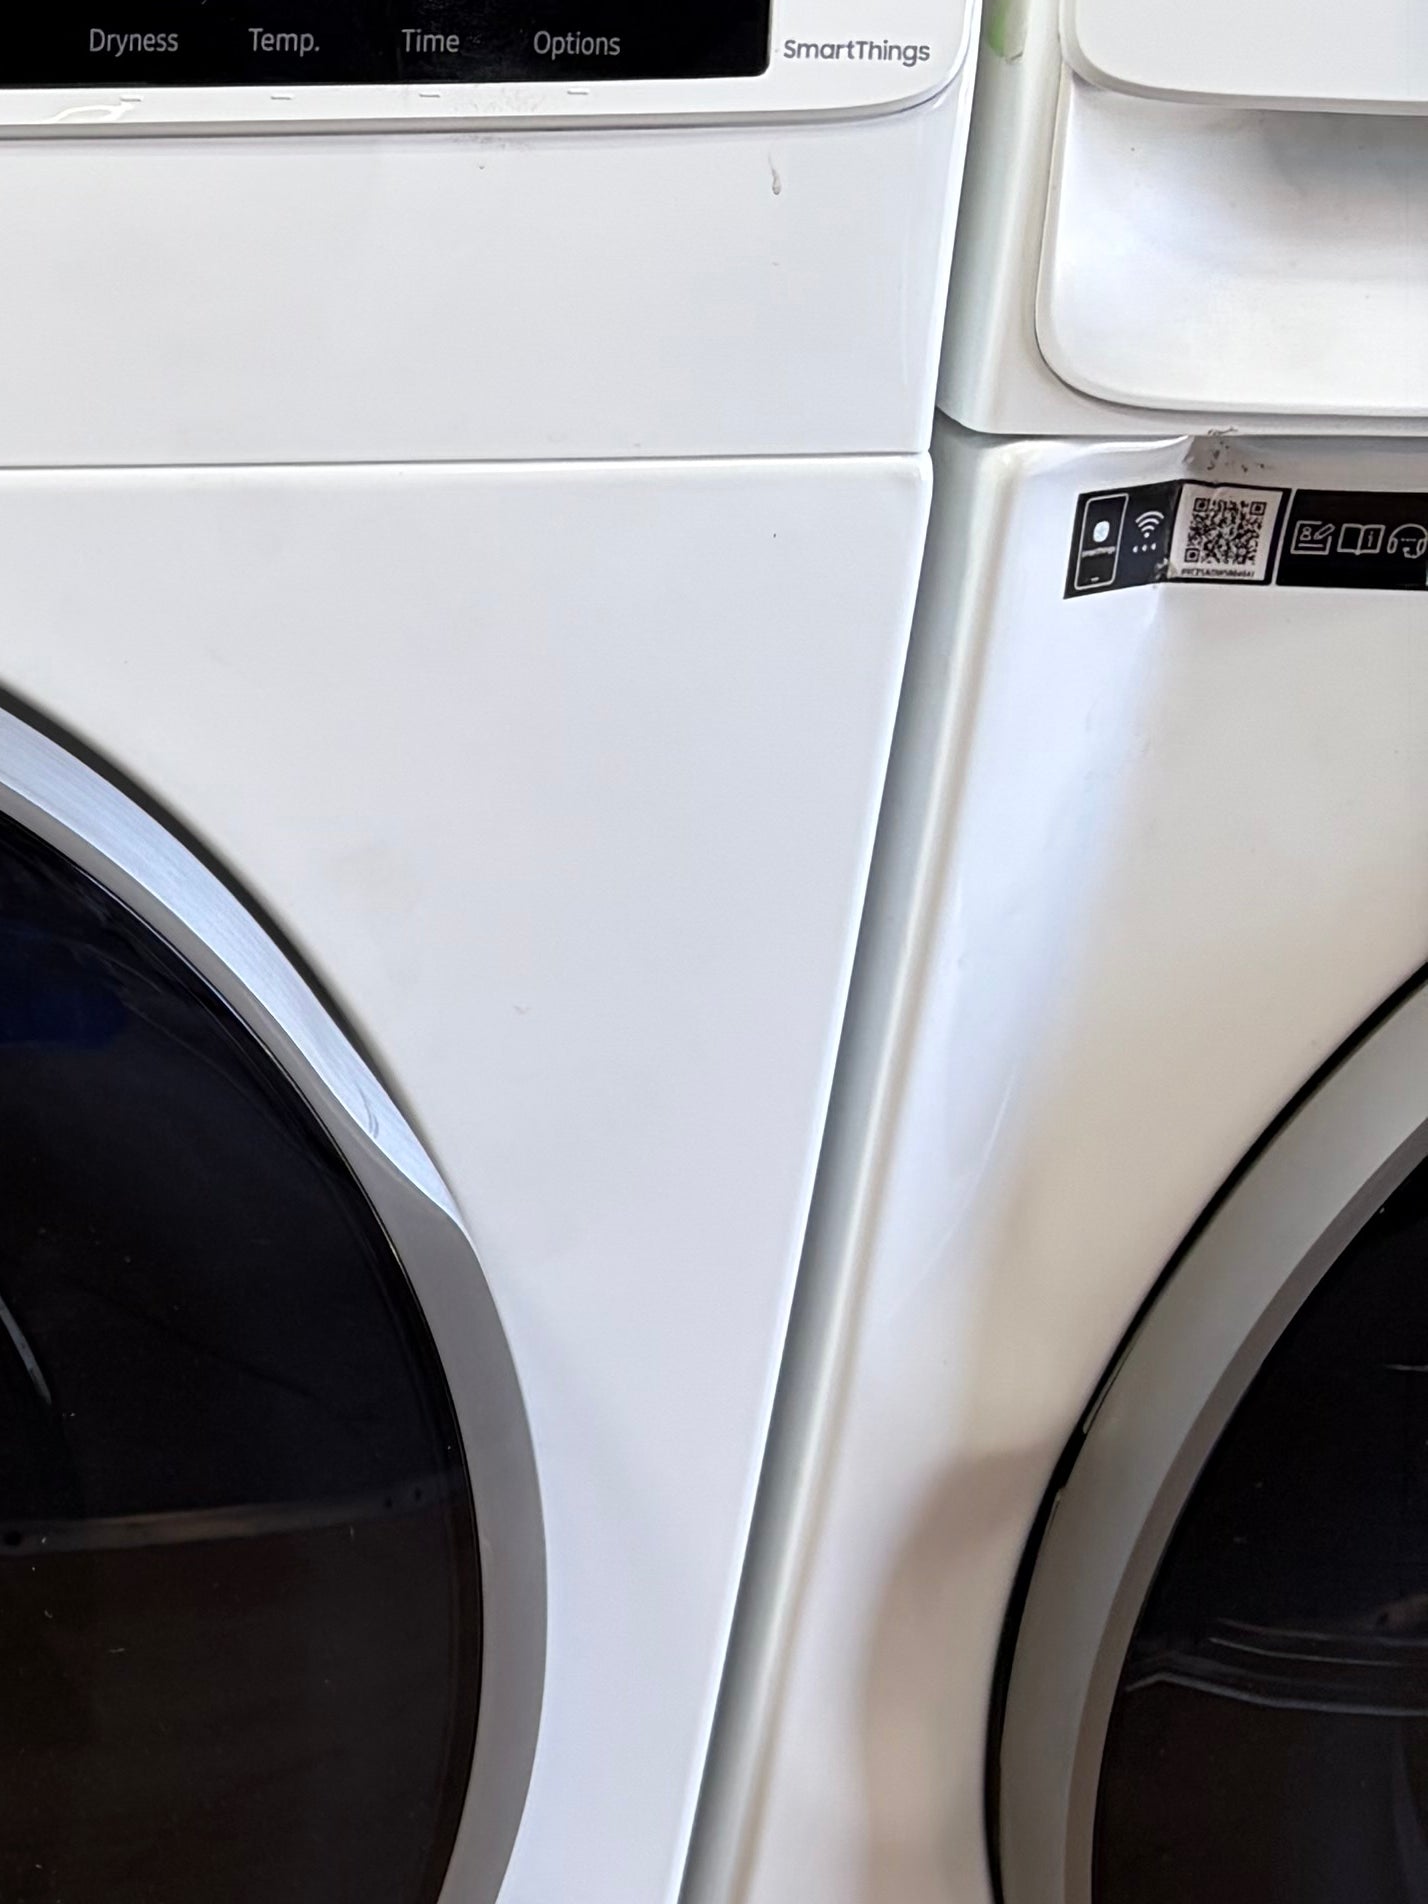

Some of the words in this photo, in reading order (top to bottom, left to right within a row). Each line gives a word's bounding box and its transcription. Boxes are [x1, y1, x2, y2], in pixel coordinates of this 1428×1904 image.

[88, 28, 178, 57] Dryness
[248, 28, 320, 57] Temp.
[401, 29, 460, 53] Time
[533, 31, 621, 61] Options
[783, 39, 931, 68] SmartThings
